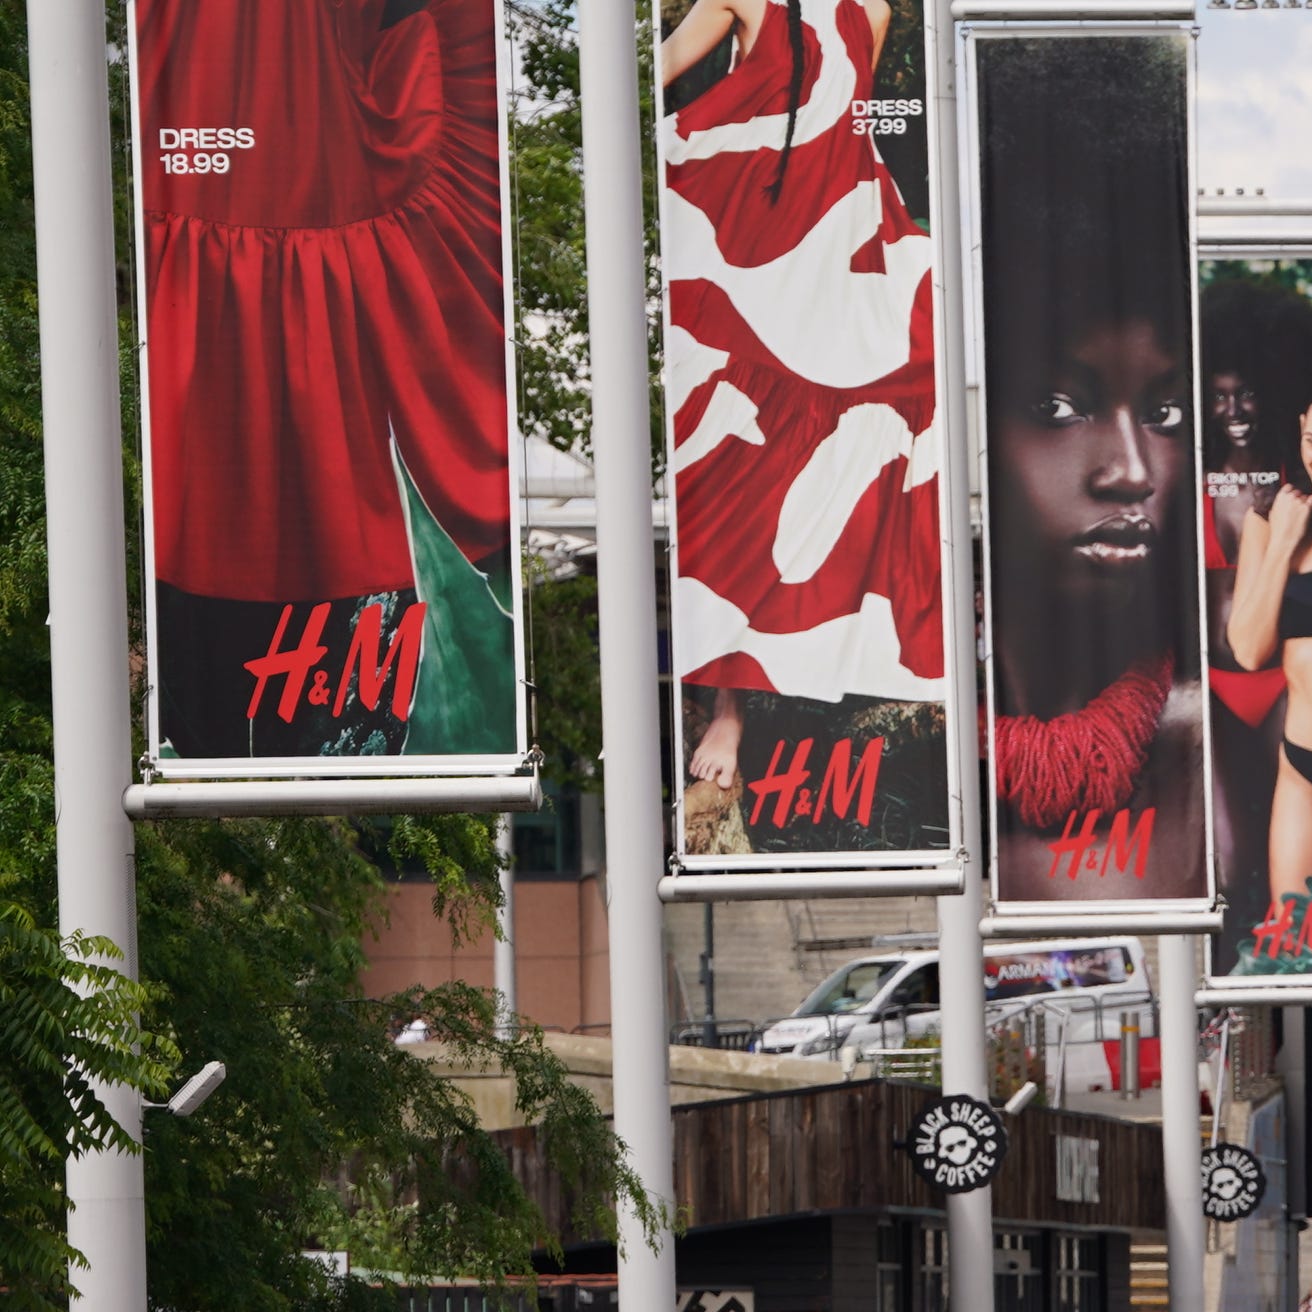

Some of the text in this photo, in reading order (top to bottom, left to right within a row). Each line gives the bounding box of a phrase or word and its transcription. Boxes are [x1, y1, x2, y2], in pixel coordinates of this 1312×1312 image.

[851, 99, 923, 117] DRESS
[159, 127, 256, 149] DRESS
[851, 118, 908, 136] 37.99
[159, 152, 231, 175] 18.99
[1249, 471, 1280, 485] TOP
[243, 601, 427, 723] H&M
[747, 736, 884, 829] H&M
[1046, 806, 1156, 880] H&M
[915, 1102, 996, 1154] BLACK SHEEP
[935, 1151, 996, 1187] COFFEE
